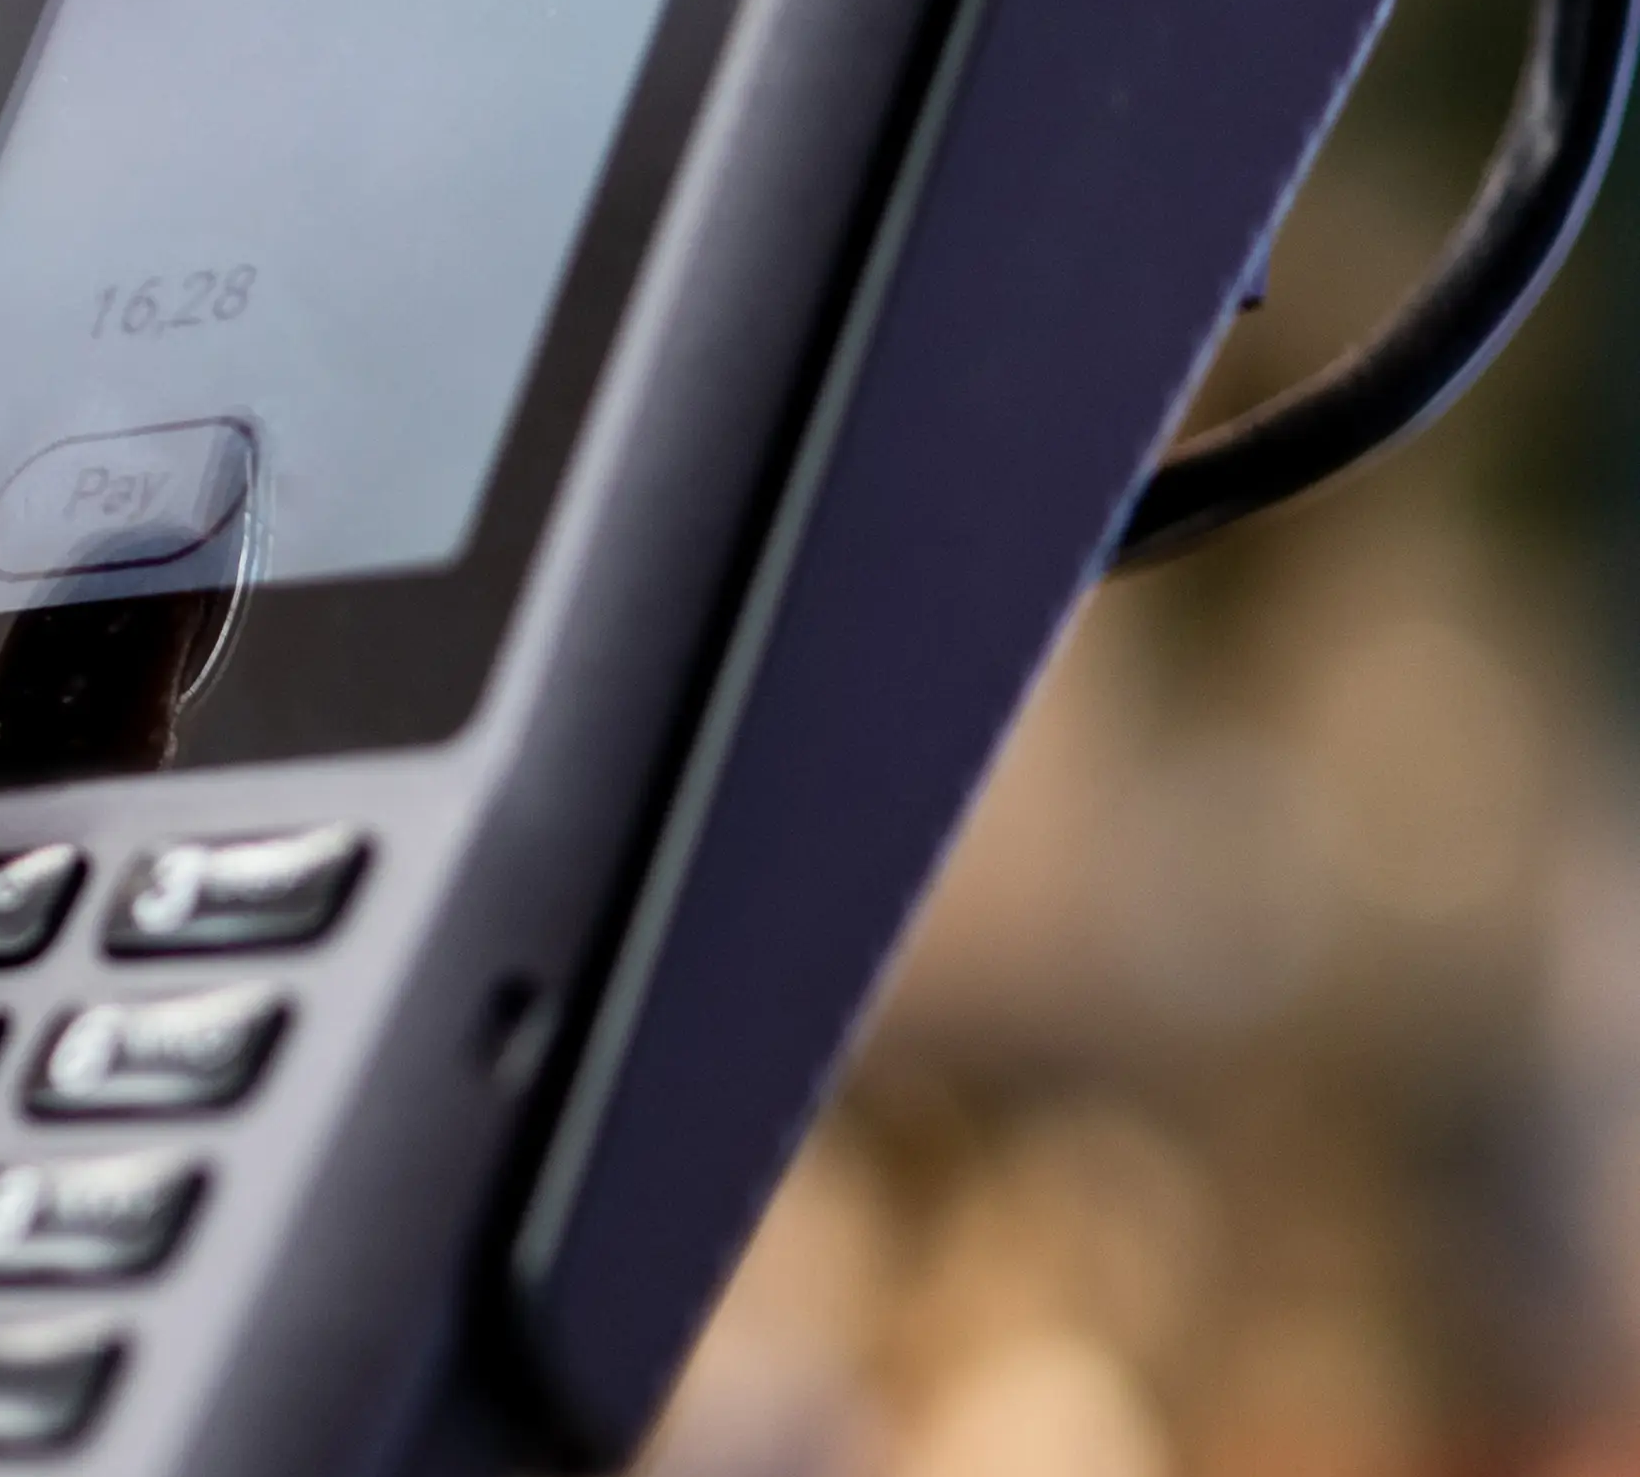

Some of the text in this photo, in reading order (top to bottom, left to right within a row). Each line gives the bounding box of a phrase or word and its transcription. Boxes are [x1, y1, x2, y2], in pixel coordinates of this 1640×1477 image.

[89, 262, 259, 342] 16,28
[62, 465, 171, 523] Pay
[131, 845, 208, 936] 3
